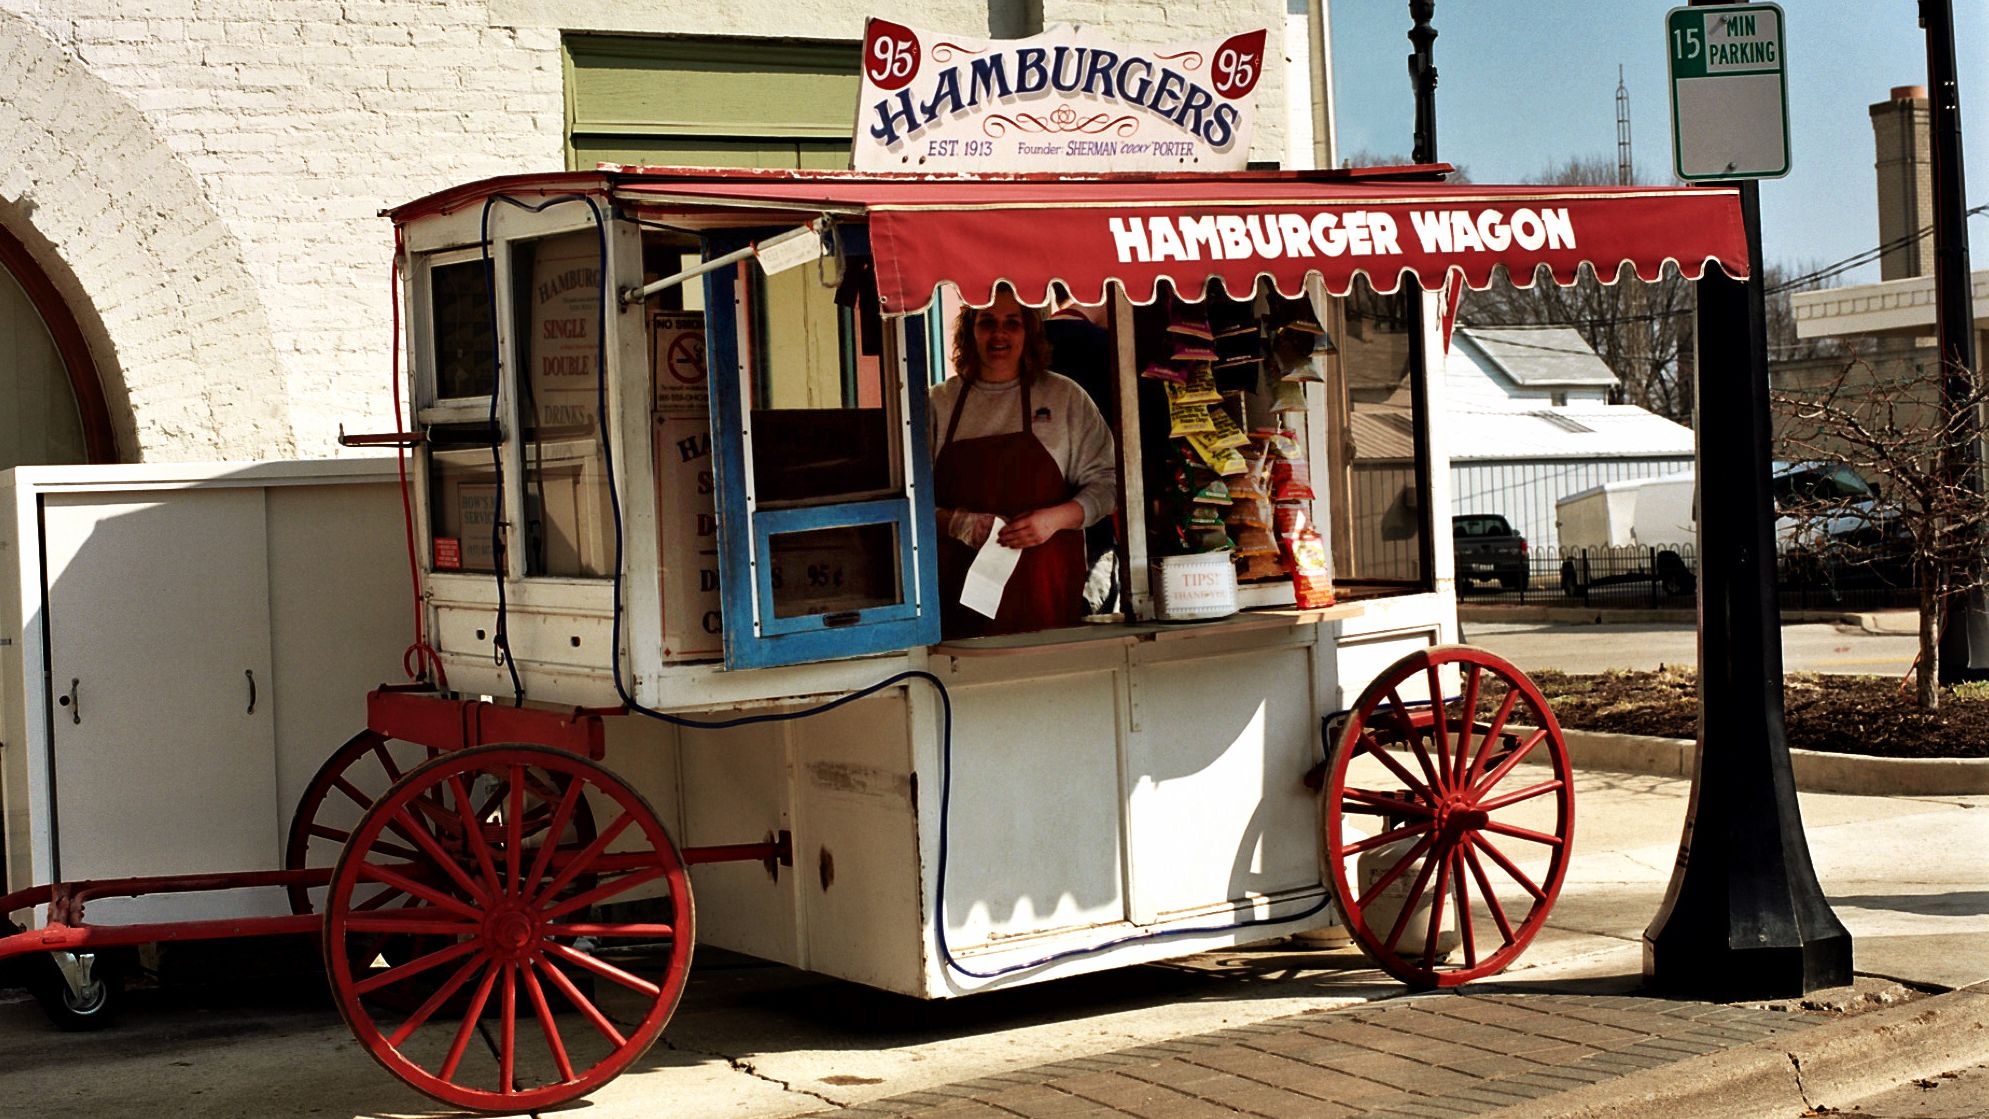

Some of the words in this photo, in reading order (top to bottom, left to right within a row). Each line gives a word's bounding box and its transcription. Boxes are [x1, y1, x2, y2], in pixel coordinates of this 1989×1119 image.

[1726, 15, 1756, 37] MIN
[1674, 28, 1700, 59] 15
[1709, 41, 1775, 65] PARKING
[870, 46, 1238, 147] HAMBURGERS
[964, 140, 993, 156] 1913
[1066, 140, 1117, 157] SHERMAN
[1153, 142, 1194, 156] PORTER
[1109, 211, 1402, 263] HAMBURGER
[1410, 208, 1576, 253] WAGON
[543, 318, 587, 339] SINGLE
[656, 319, 673, 330] NO
[542, 355, 589, 376] DOUBLE
[544, 404, 586, 425] DRINKS
